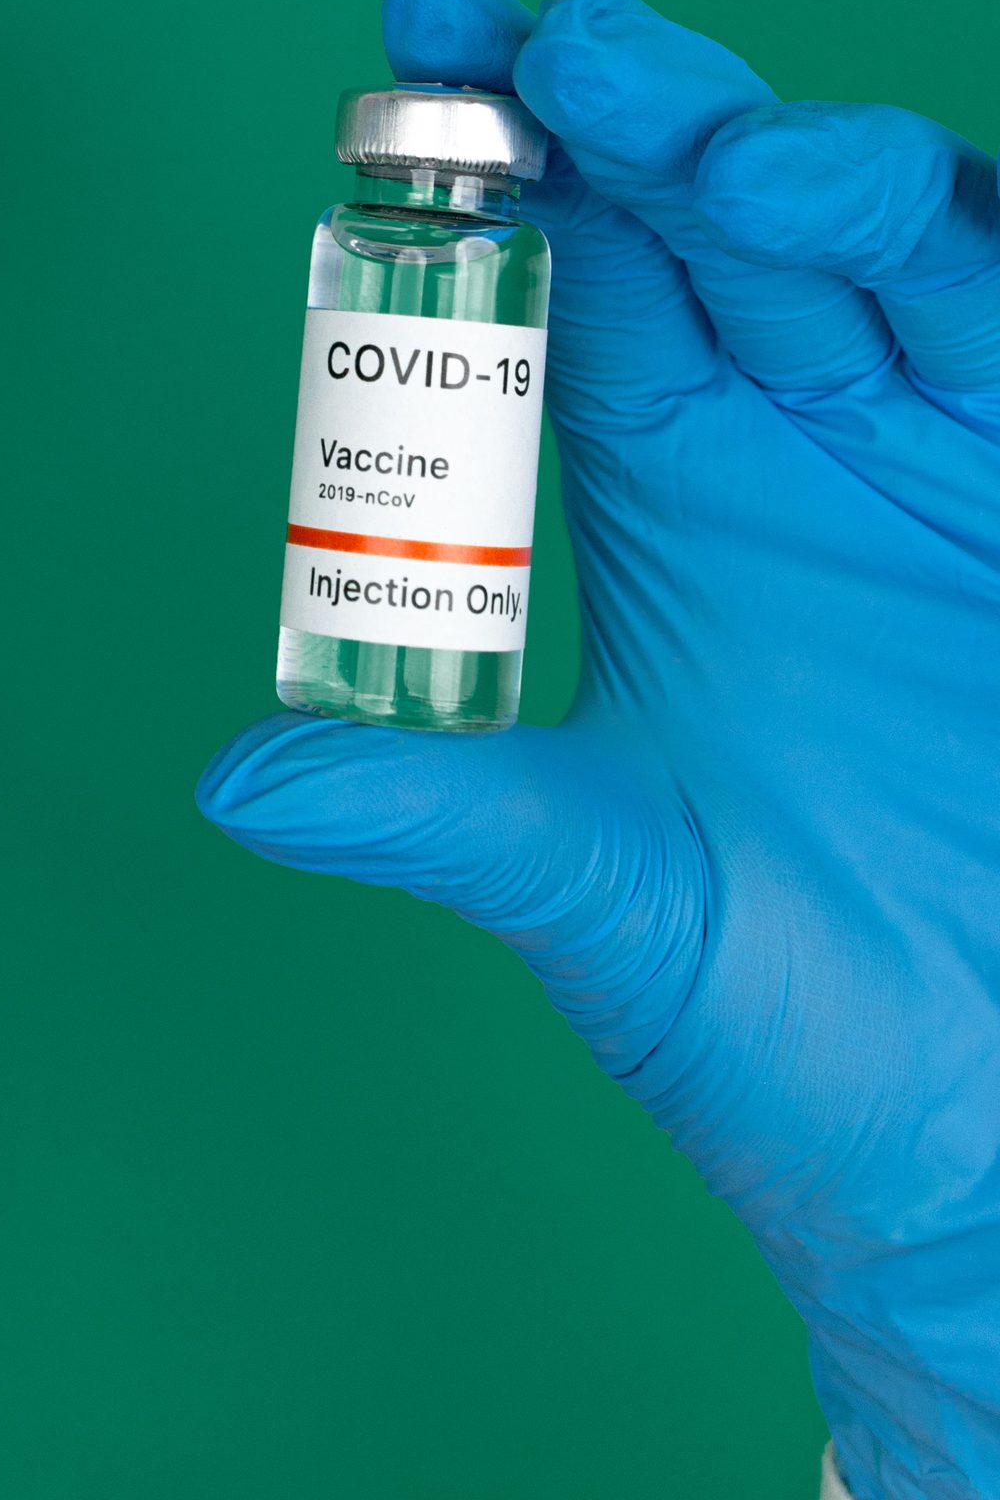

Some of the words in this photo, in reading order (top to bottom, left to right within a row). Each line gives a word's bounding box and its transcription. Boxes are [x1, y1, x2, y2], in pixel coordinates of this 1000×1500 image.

[327, 341, 531, 397] COVID-19
[320, 438, 450, 479] Vaccine
[318, 483, 416, 508] 2019-nCoV
[309, 566, 454, 612] Injection
[466, 584, 523, 622] Only.
